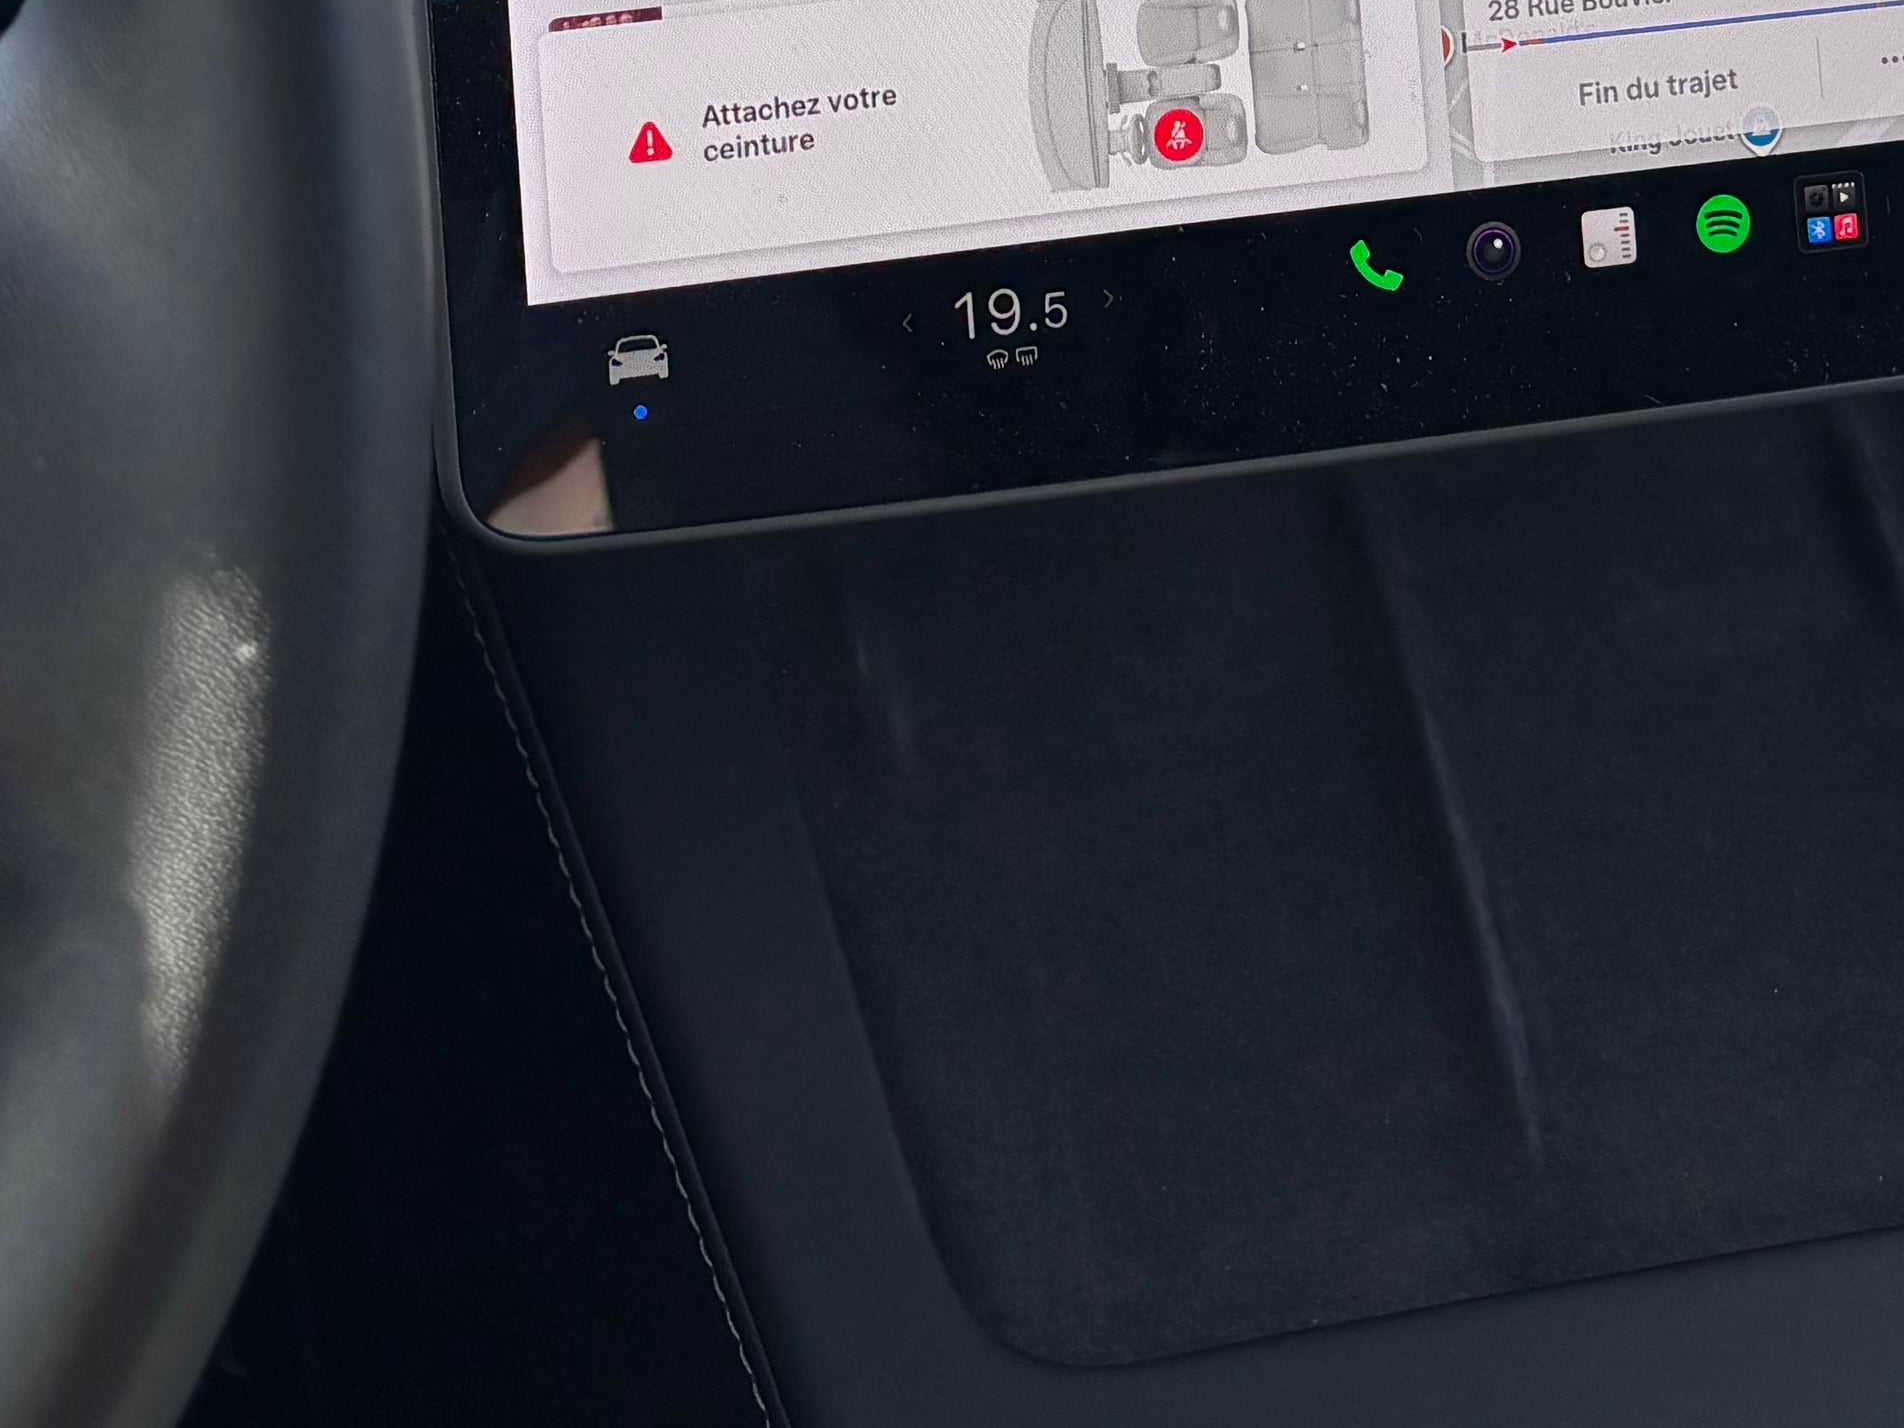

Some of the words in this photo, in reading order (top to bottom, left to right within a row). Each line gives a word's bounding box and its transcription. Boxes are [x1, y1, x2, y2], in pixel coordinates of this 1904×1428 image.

[703, 94, 820, 128] Attachez
[827, 86, 897, 114] votre
[1579, 81, 1619, 107] Fin
[1626, 75, 1659, 101] du
[1666, 67, 1739, 99] trajet
[703, 129, 815, 163] ceinture
[954, 287, 1068, 340] 19.5
